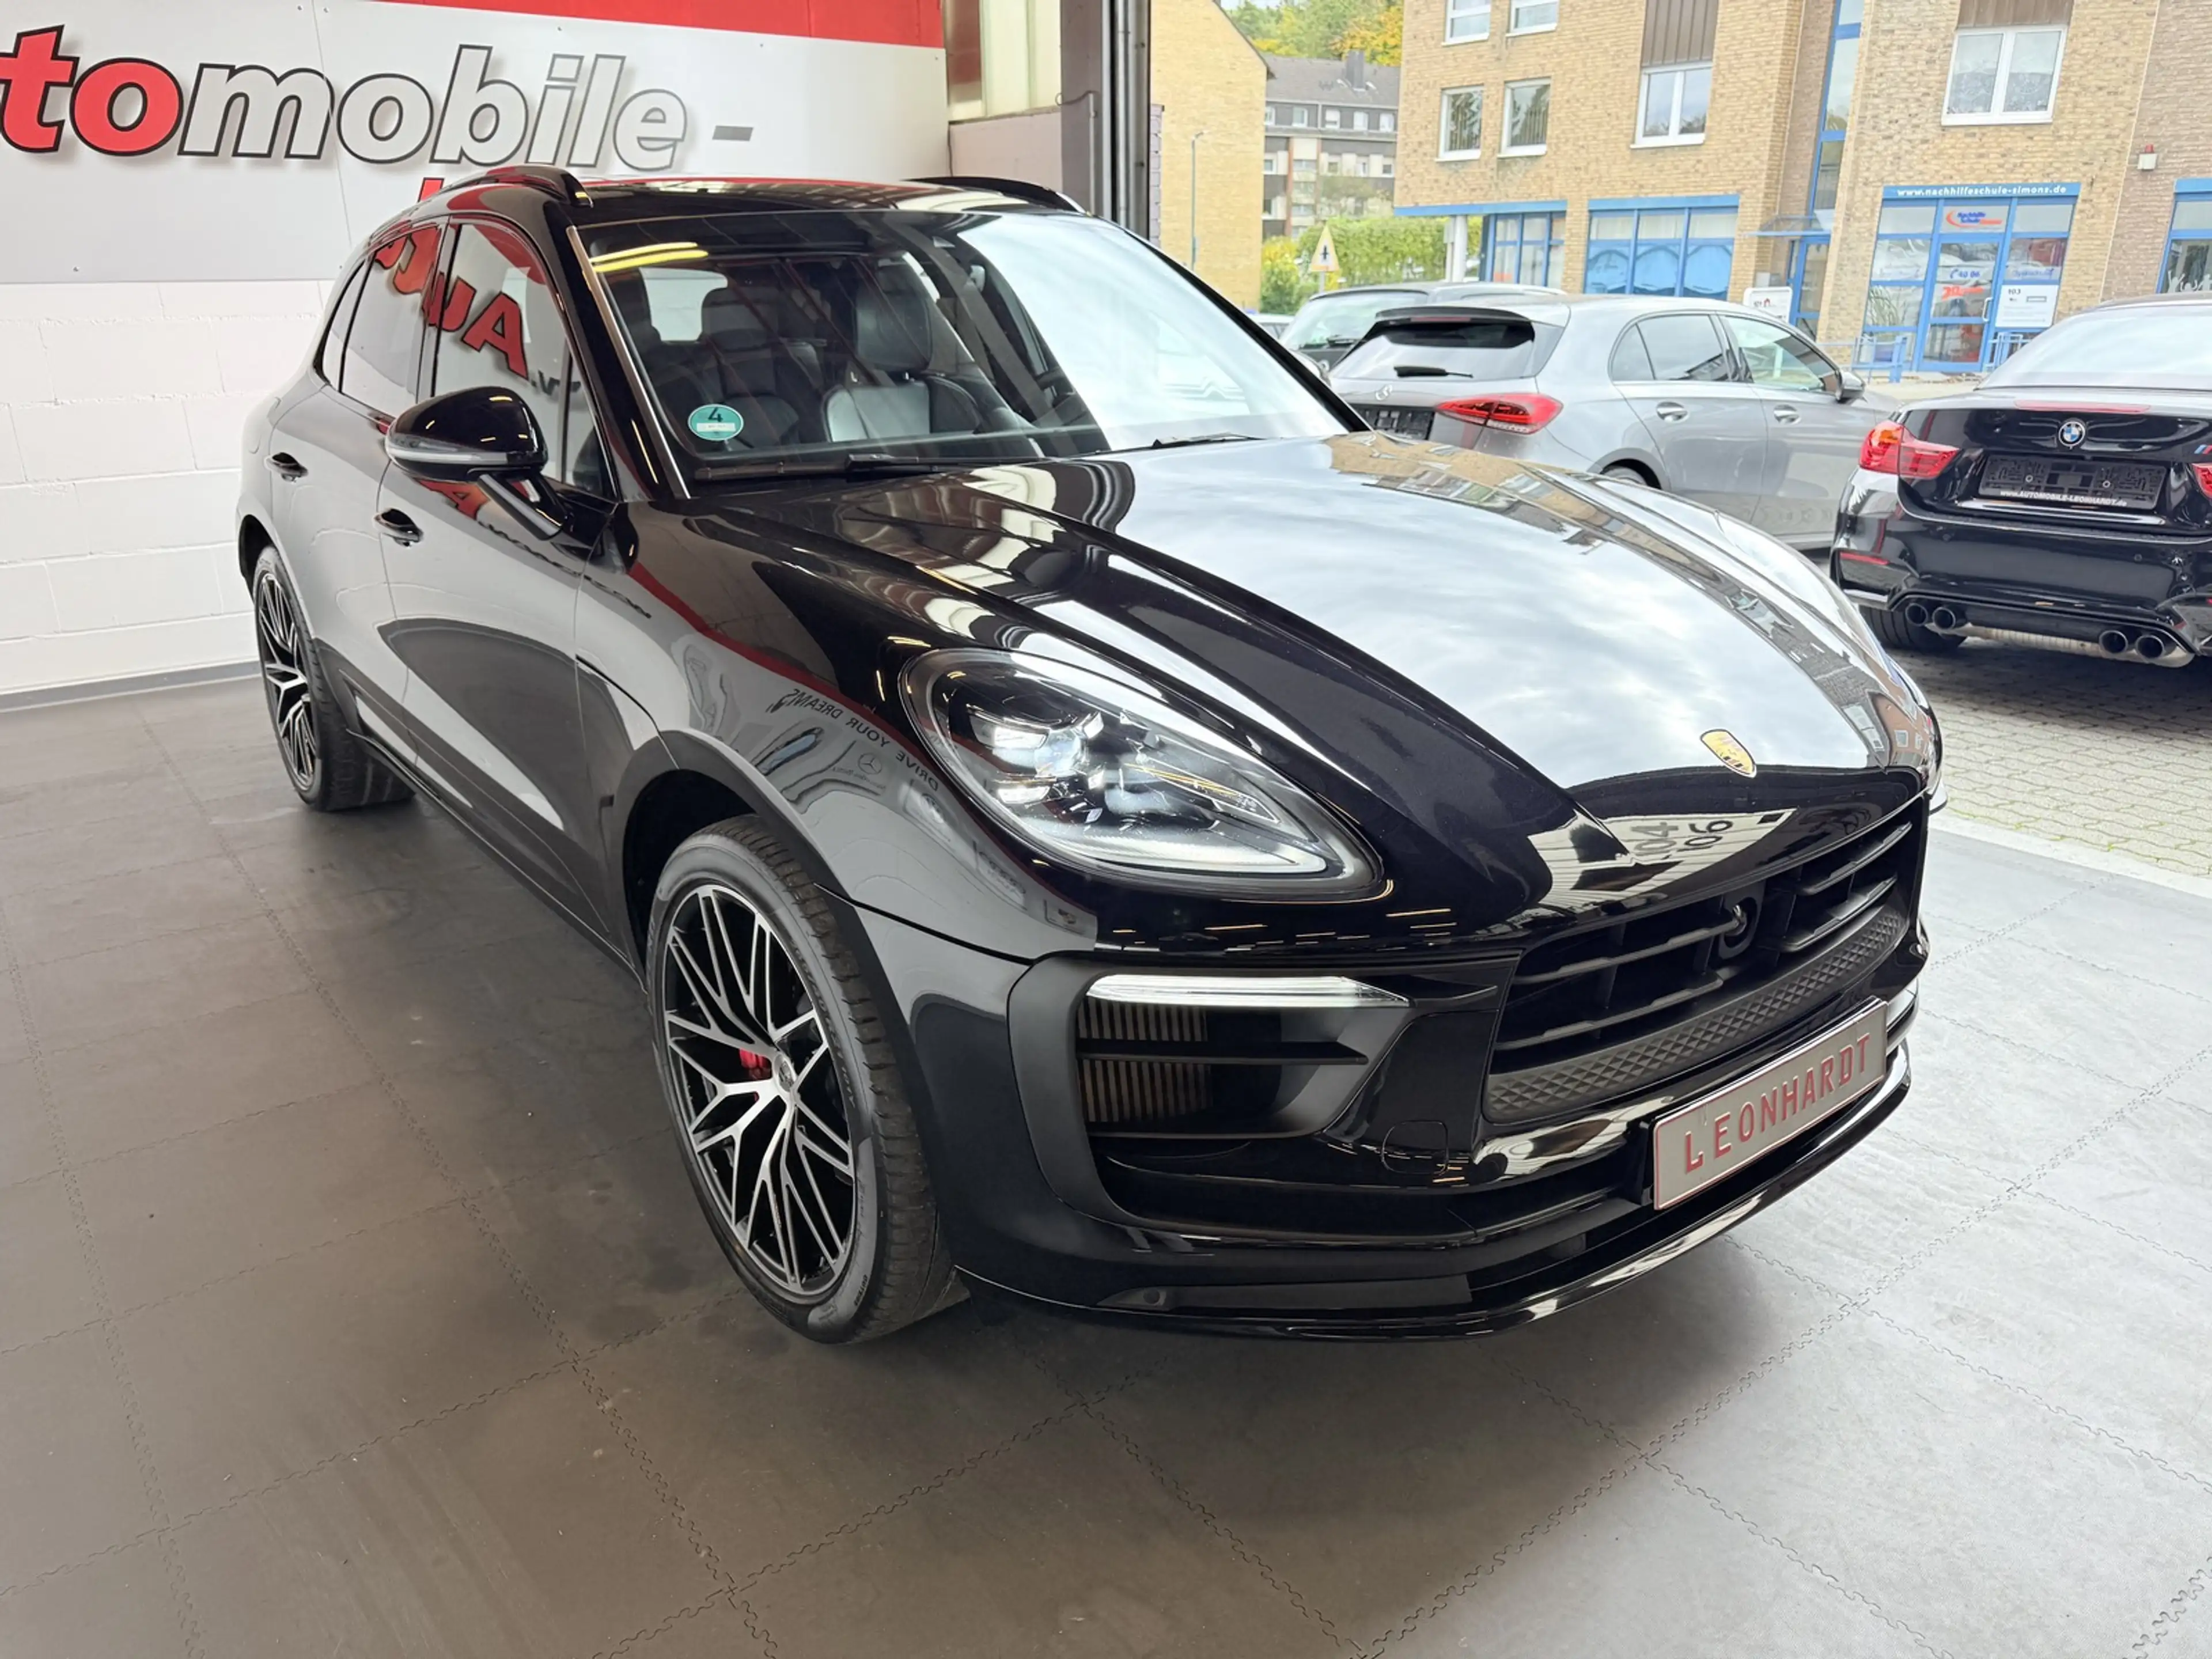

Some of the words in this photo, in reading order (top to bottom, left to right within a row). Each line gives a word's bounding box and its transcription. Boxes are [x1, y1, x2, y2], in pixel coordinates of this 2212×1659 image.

[707, 406, 724, 423] 4
[2000, 490, 2127, 507] www.AUTOMOBILE-LEONHARDT.de
[1684, 1032, 1870, 1174] LEONHARDT
